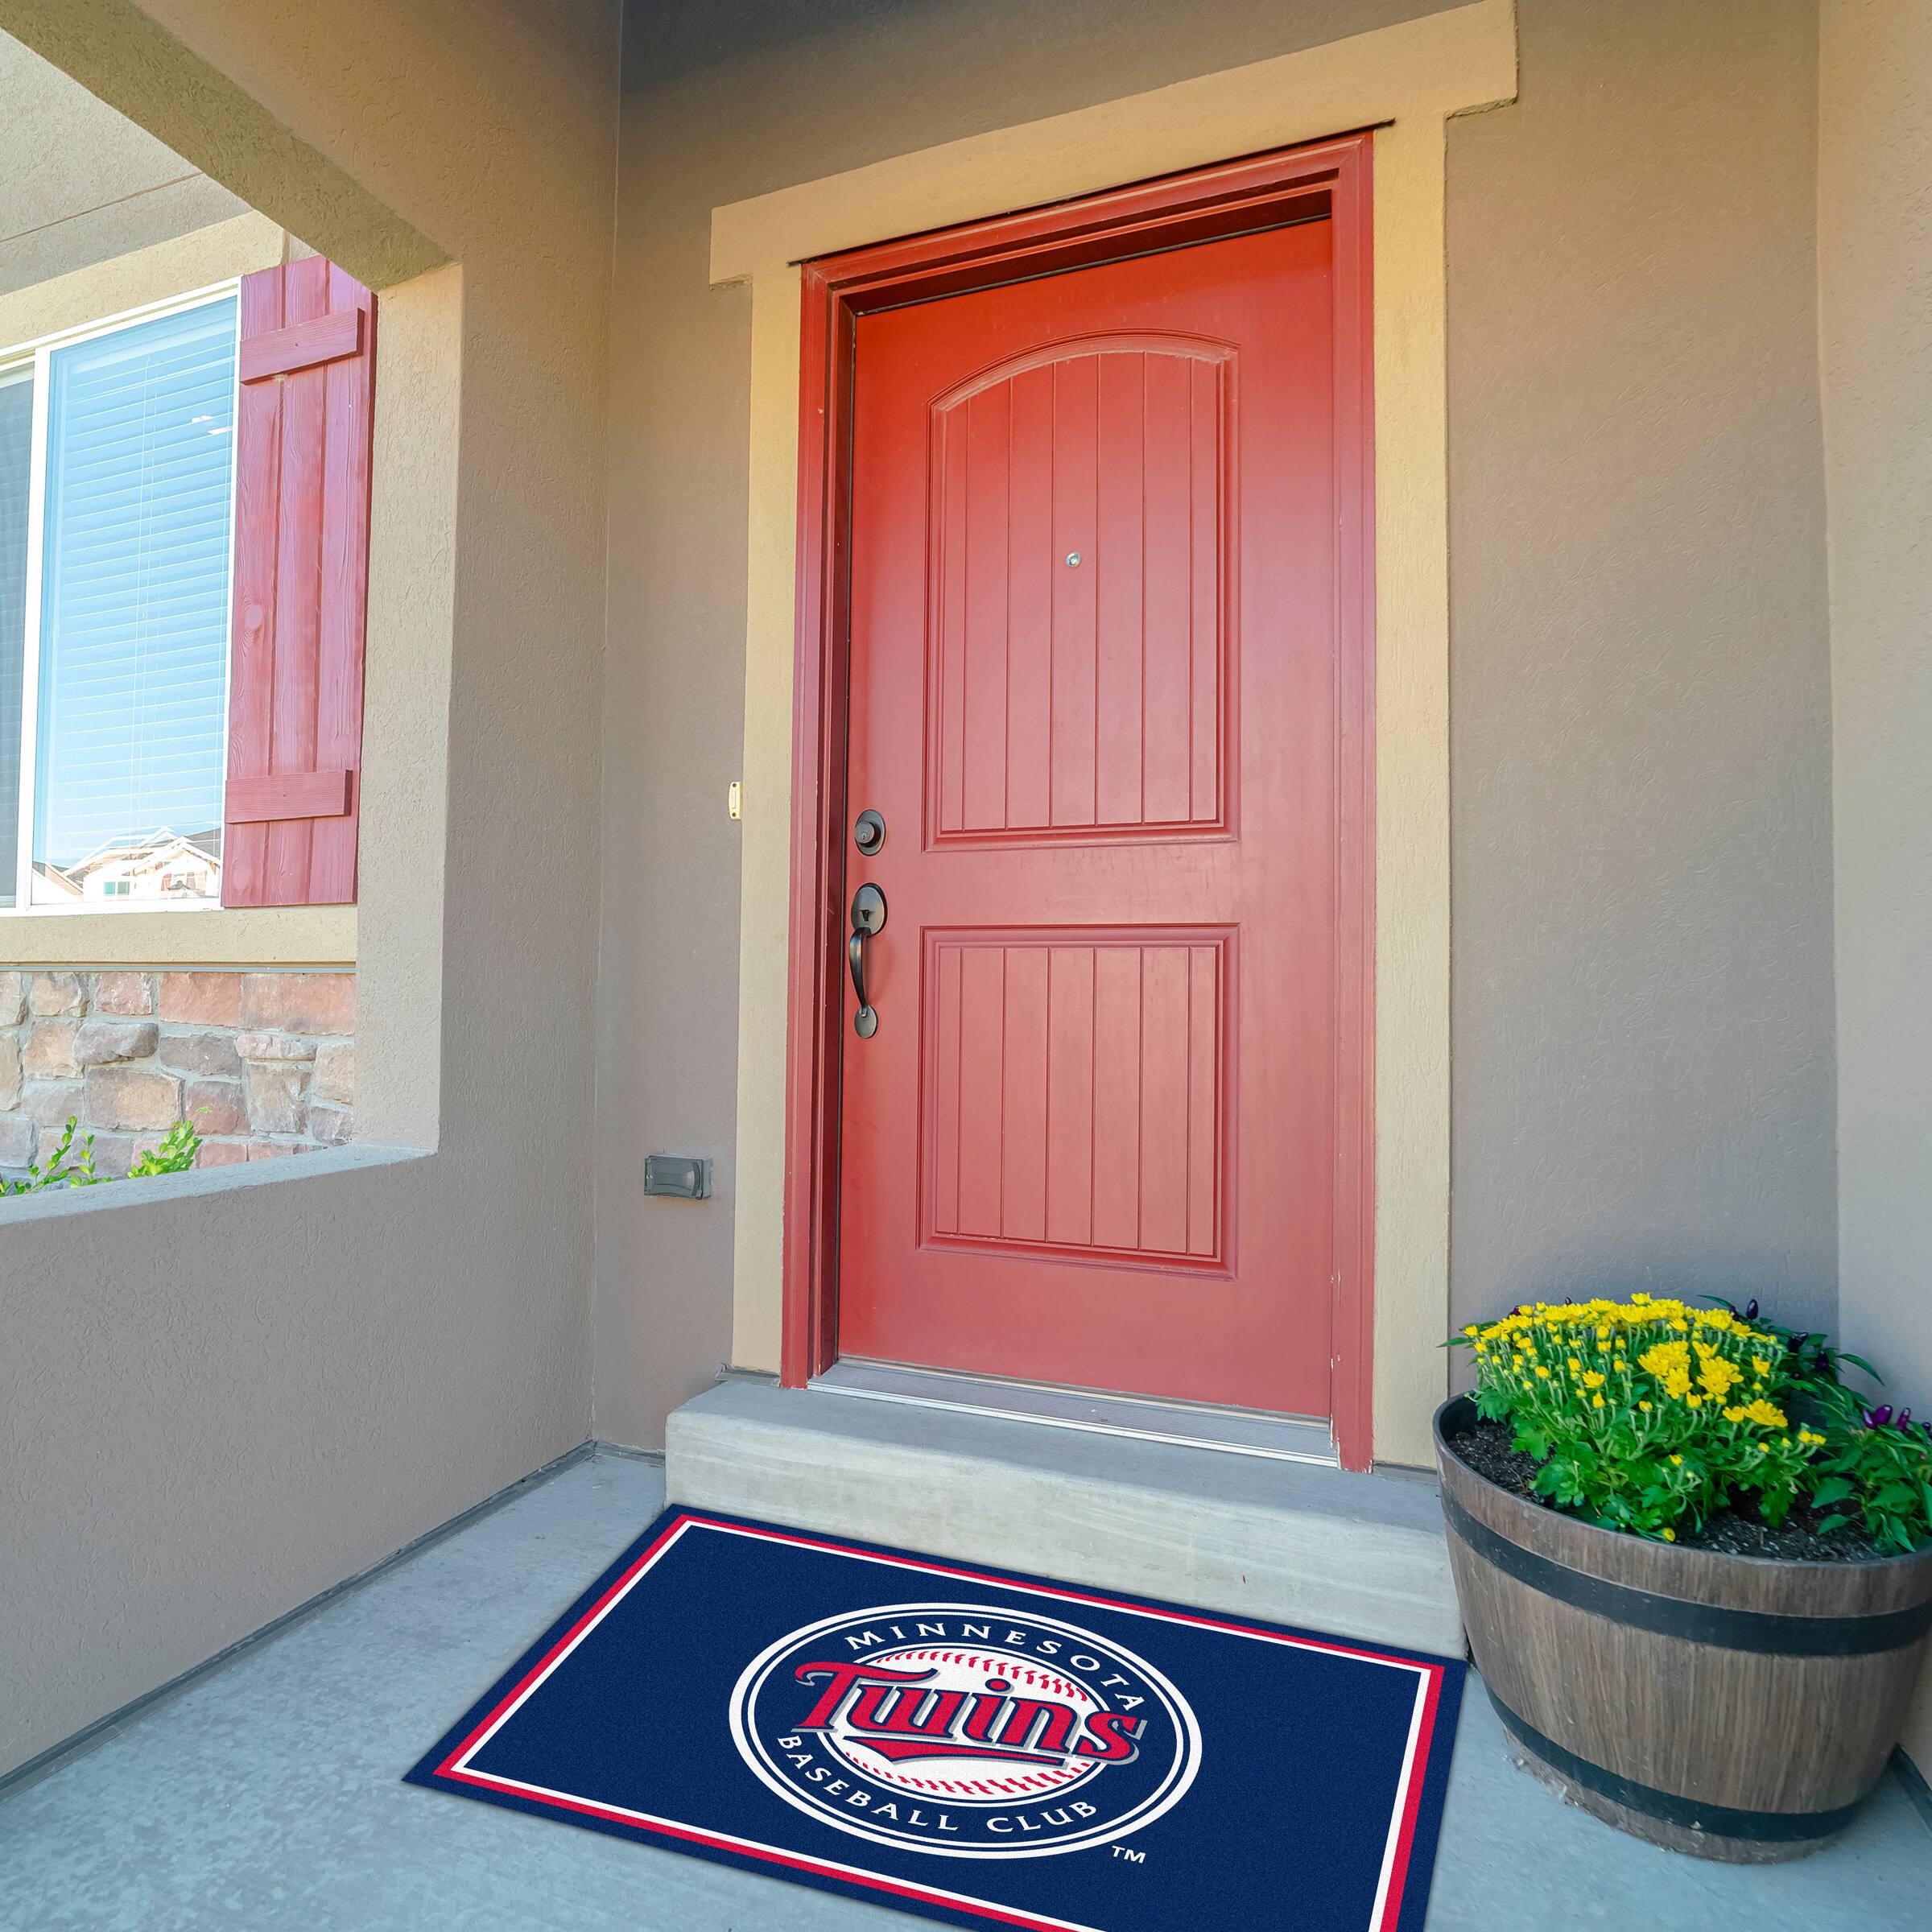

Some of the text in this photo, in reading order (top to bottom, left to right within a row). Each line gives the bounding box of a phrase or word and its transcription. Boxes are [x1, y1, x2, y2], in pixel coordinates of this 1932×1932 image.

[791, 1661, 1148, 1765] Twins
[844, 1622, 1146, 1711] MINNESOTA
[777, 1735, 1098, 1833] BASEBALL CLUB
